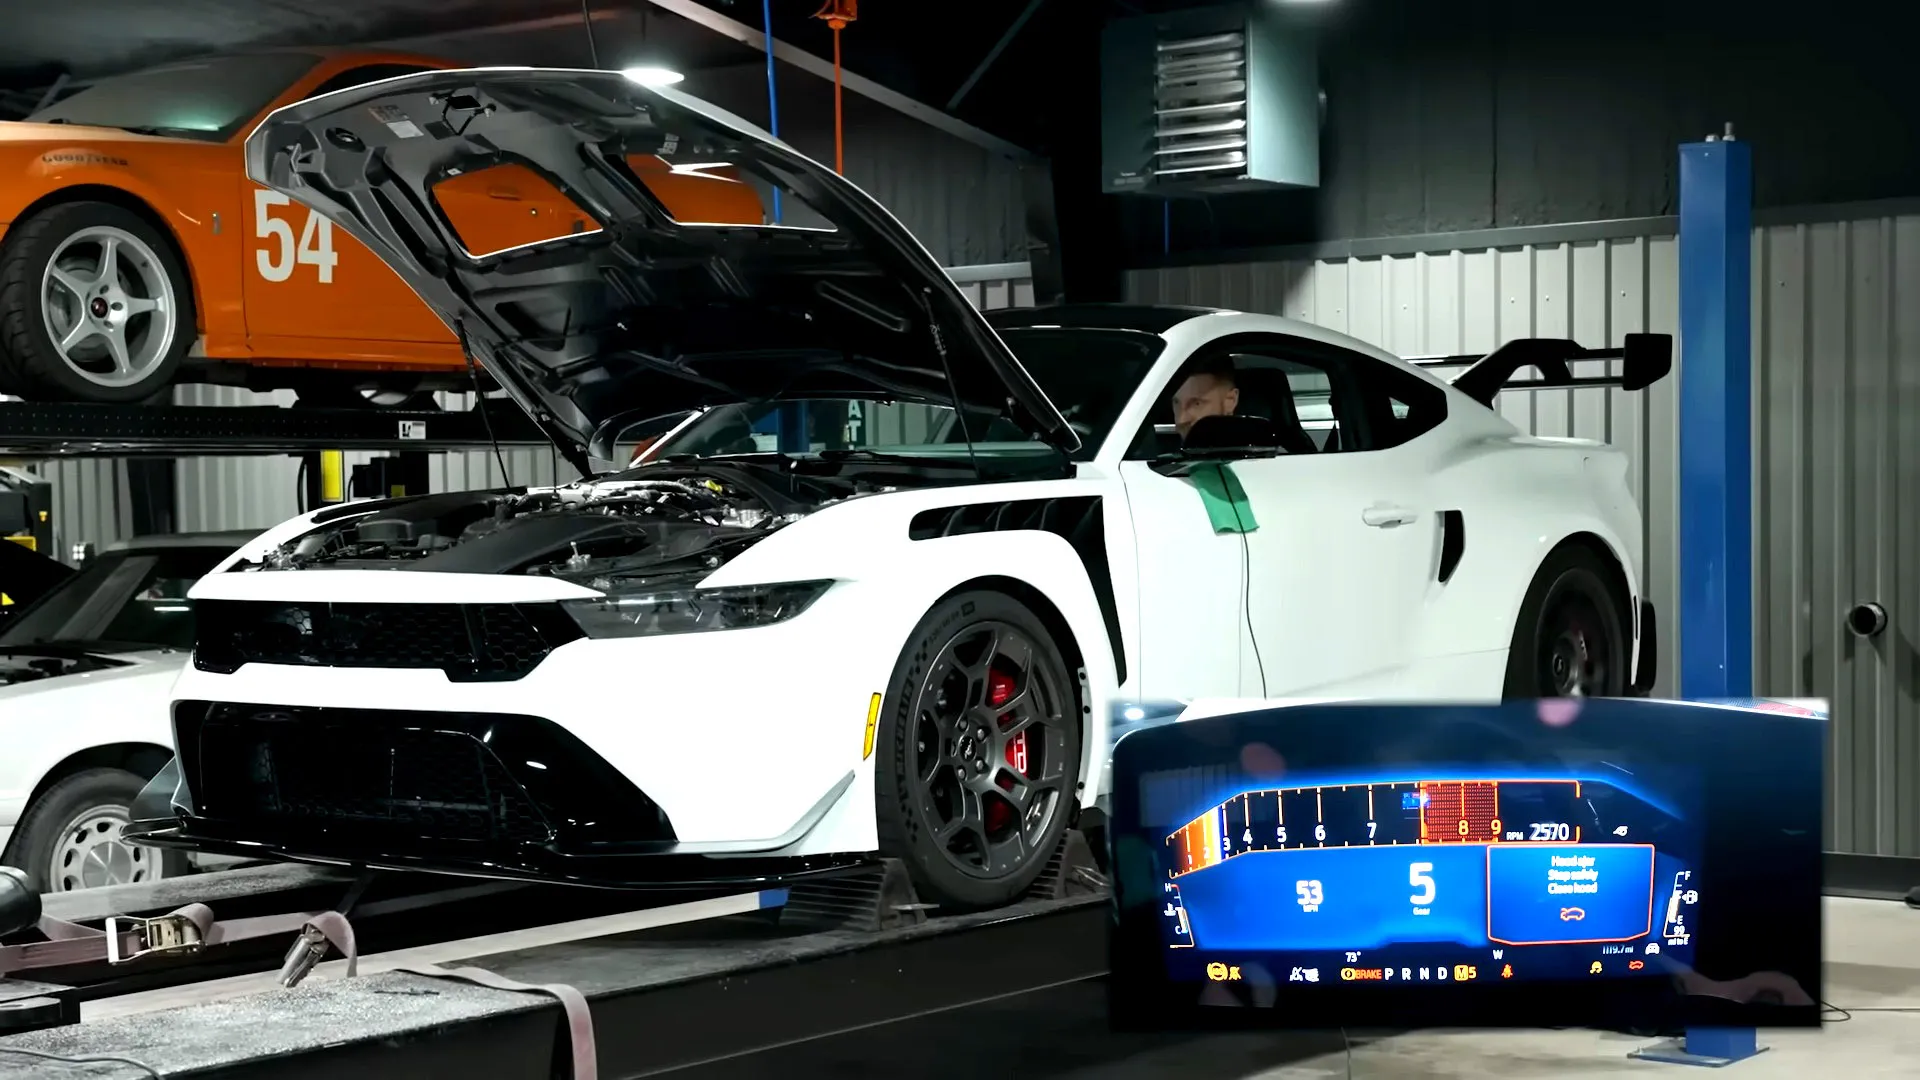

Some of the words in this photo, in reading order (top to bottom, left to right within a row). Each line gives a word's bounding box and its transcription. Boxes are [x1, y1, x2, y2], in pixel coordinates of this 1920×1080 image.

[254, 188, 338, 284] 54
[1506, 831, 1524, 841] RPM
[1529, 822, 1570, 841] 2570
[1188, 855, 1193, 865] 1
[1223, 837, 1231, 851] 3
[1242, 829, 1253, 844] 4
[1276, 826, 1287, 843] 5
[1314, 824, 1326, 841] 6
[1366, 822, 1377, 839] 7
[1458, 820, 1469, 836] 8
[1490, 819, 1502, 835] 9
[1684, 870, 1692, 881] F
[1164, 882, 1172, 892] H
[1409, 862, 1436, 905] 5
[1296, 879, 1324, 905] 53
[1676, 914, 1684, 925] E
[1493, 949, 1503, 960] W
[1355, 968, 1382, 980] BRAKE
[1384, 967, 1394, 980] P
[1401, 967, 1412, 981] R
[1419, 967, 1430, 980] N
[1437, 966, 1448, 980] D
